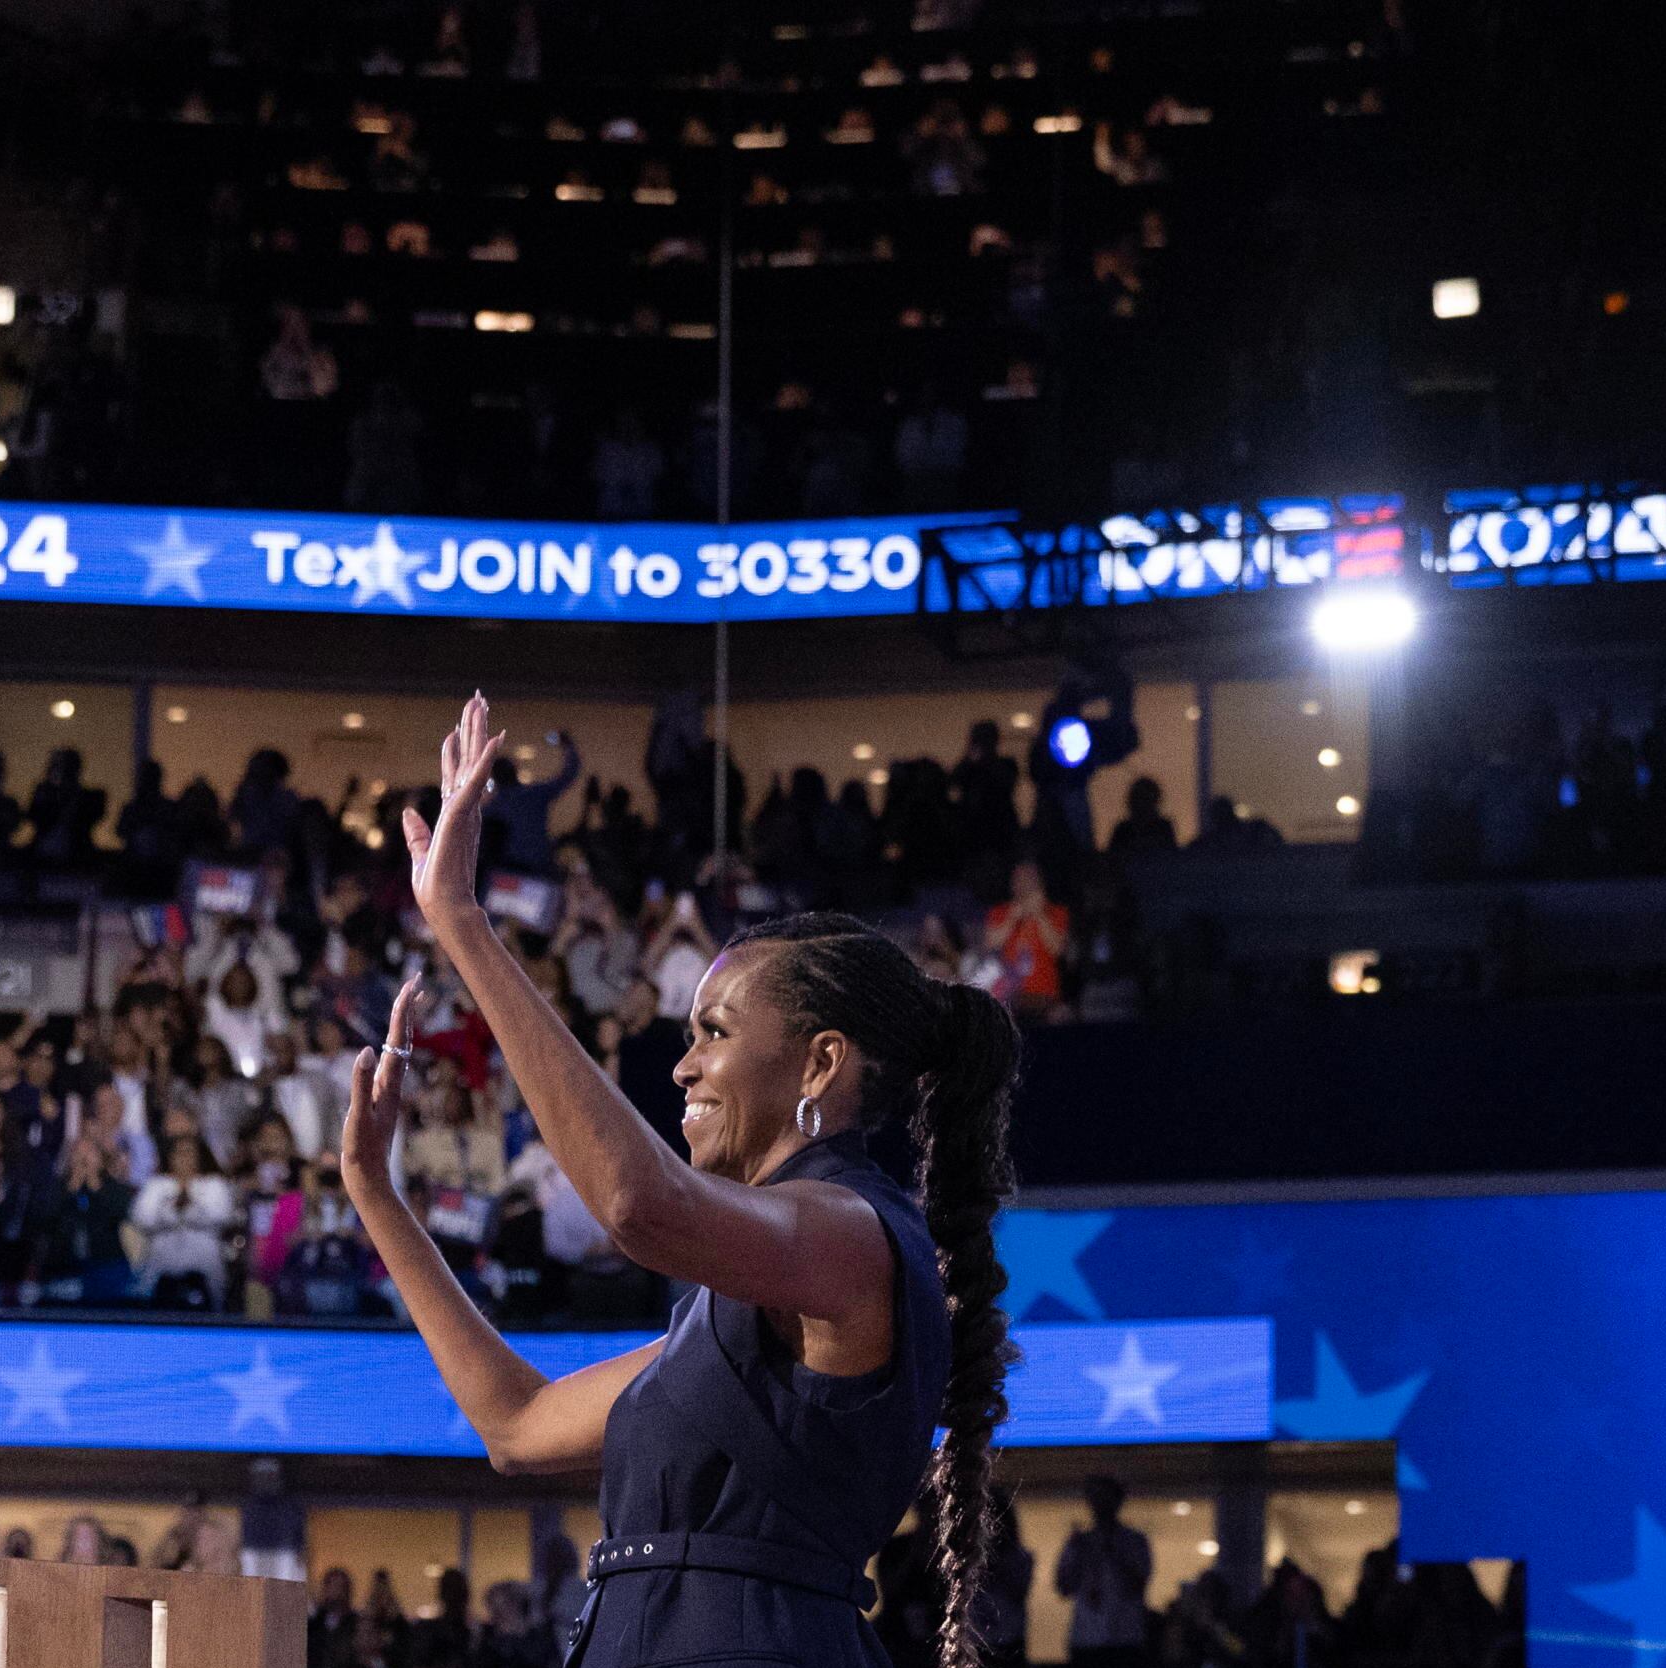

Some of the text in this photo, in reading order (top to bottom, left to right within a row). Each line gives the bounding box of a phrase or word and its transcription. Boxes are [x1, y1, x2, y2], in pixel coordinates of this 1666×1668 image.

[252, 531, 921, 599] Text JOIN to 30330
